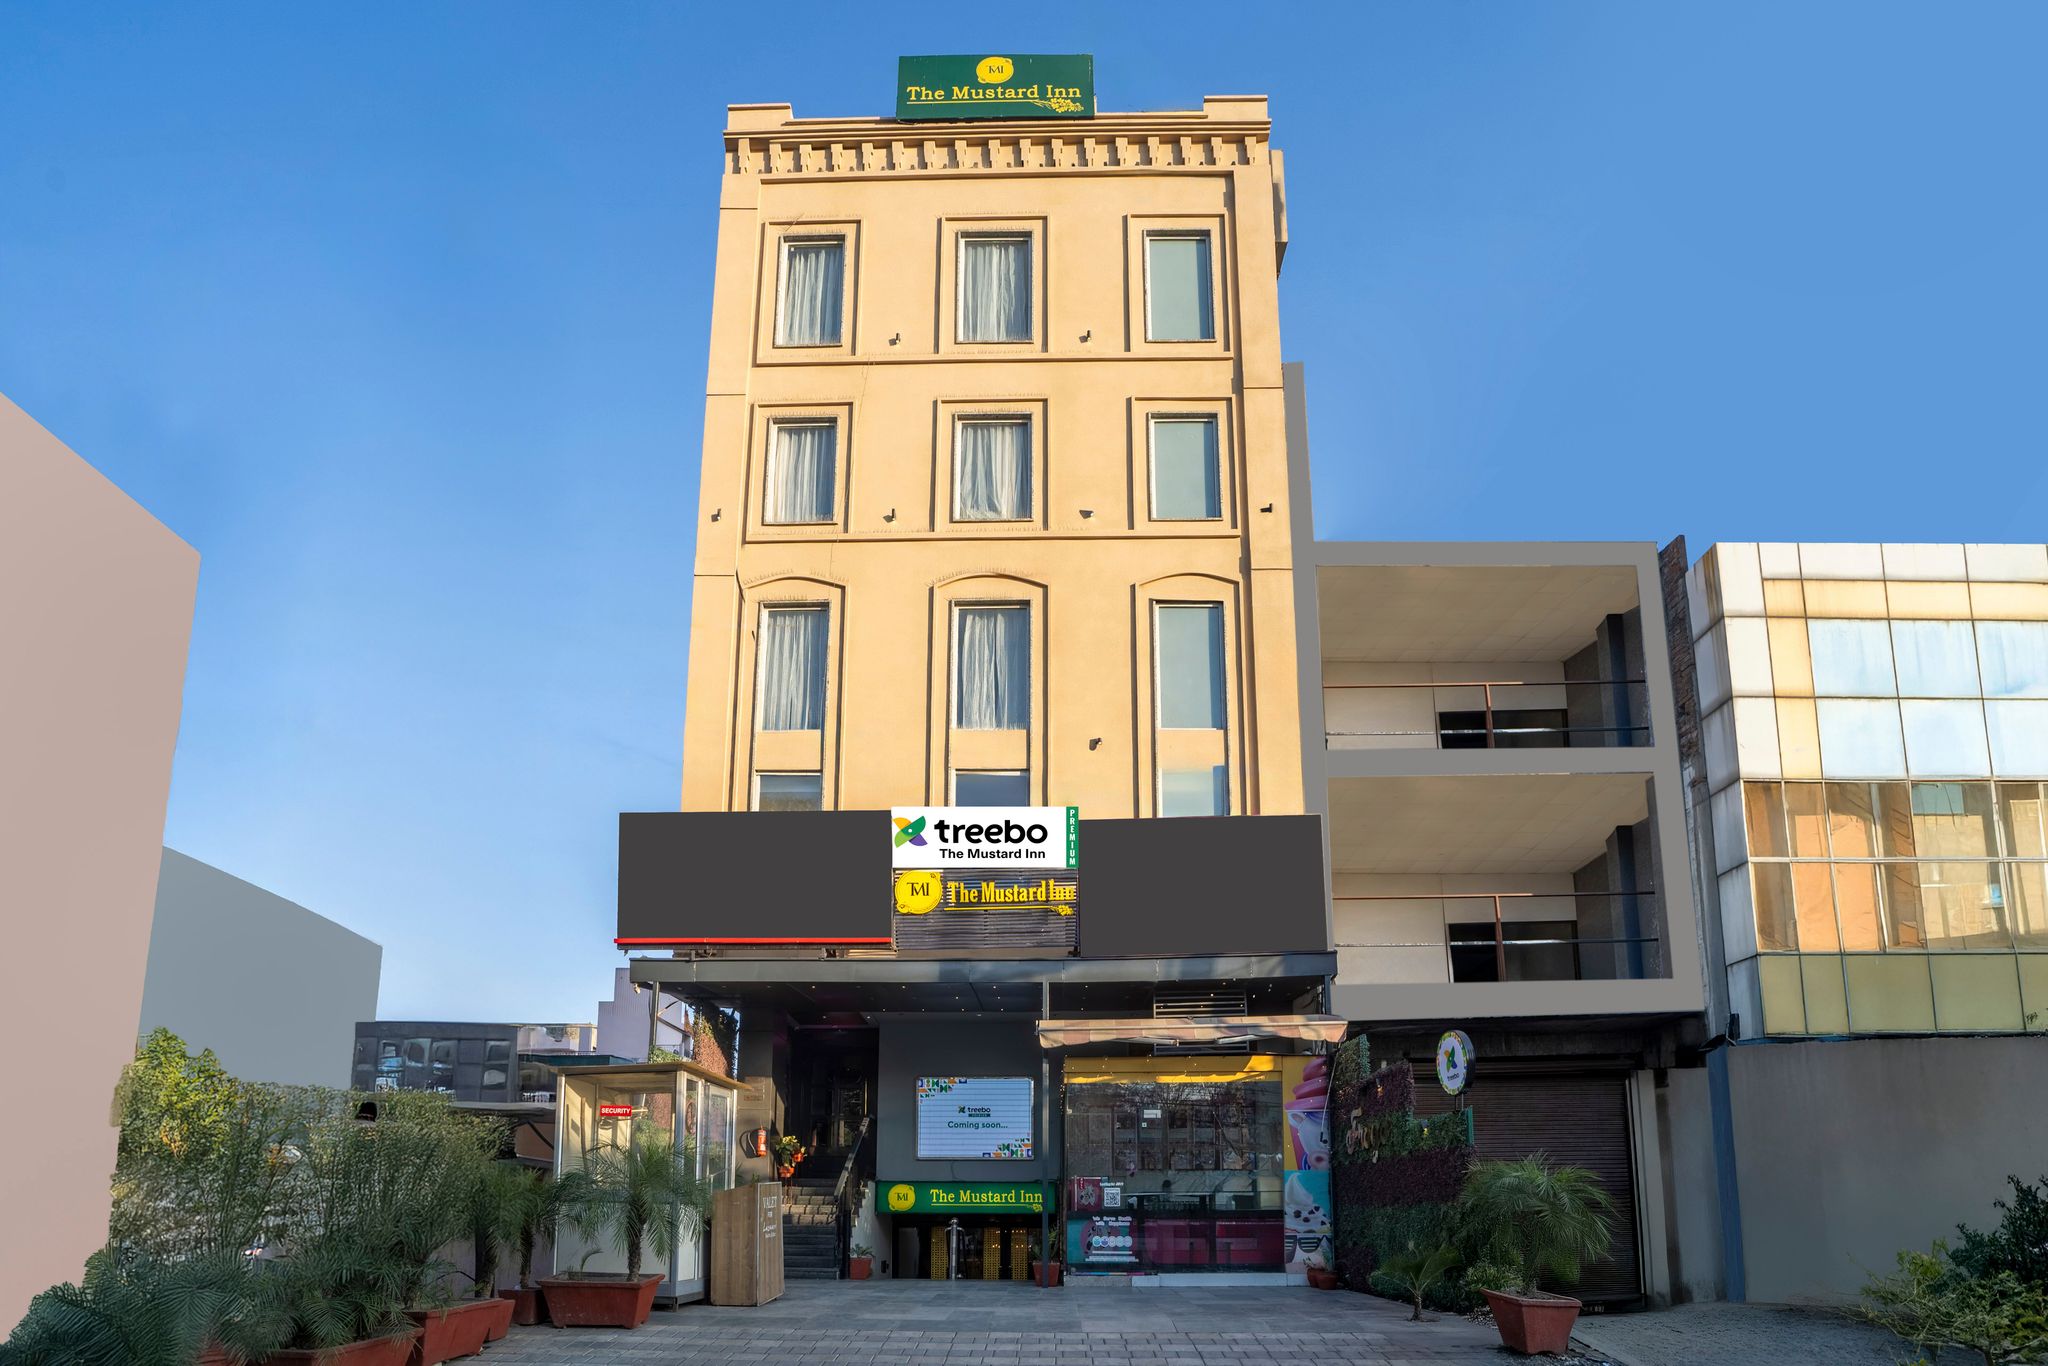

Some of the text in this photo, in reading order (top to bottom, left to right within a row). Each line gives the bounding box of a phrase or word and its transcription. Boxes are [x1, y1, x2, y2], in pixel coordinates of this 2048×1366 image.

[907, 84, 1081, 100] The Mustard Inn
[934, 820, 1048, 844] treebo
[939, 849, 1046, 859] The Mustard Inn
[948, 879, 1074, 903] The Mustard Inn
[948, 1121, 979, 1130] Coming
[930, 1189, 1043, 1202] The Mustard Inn
